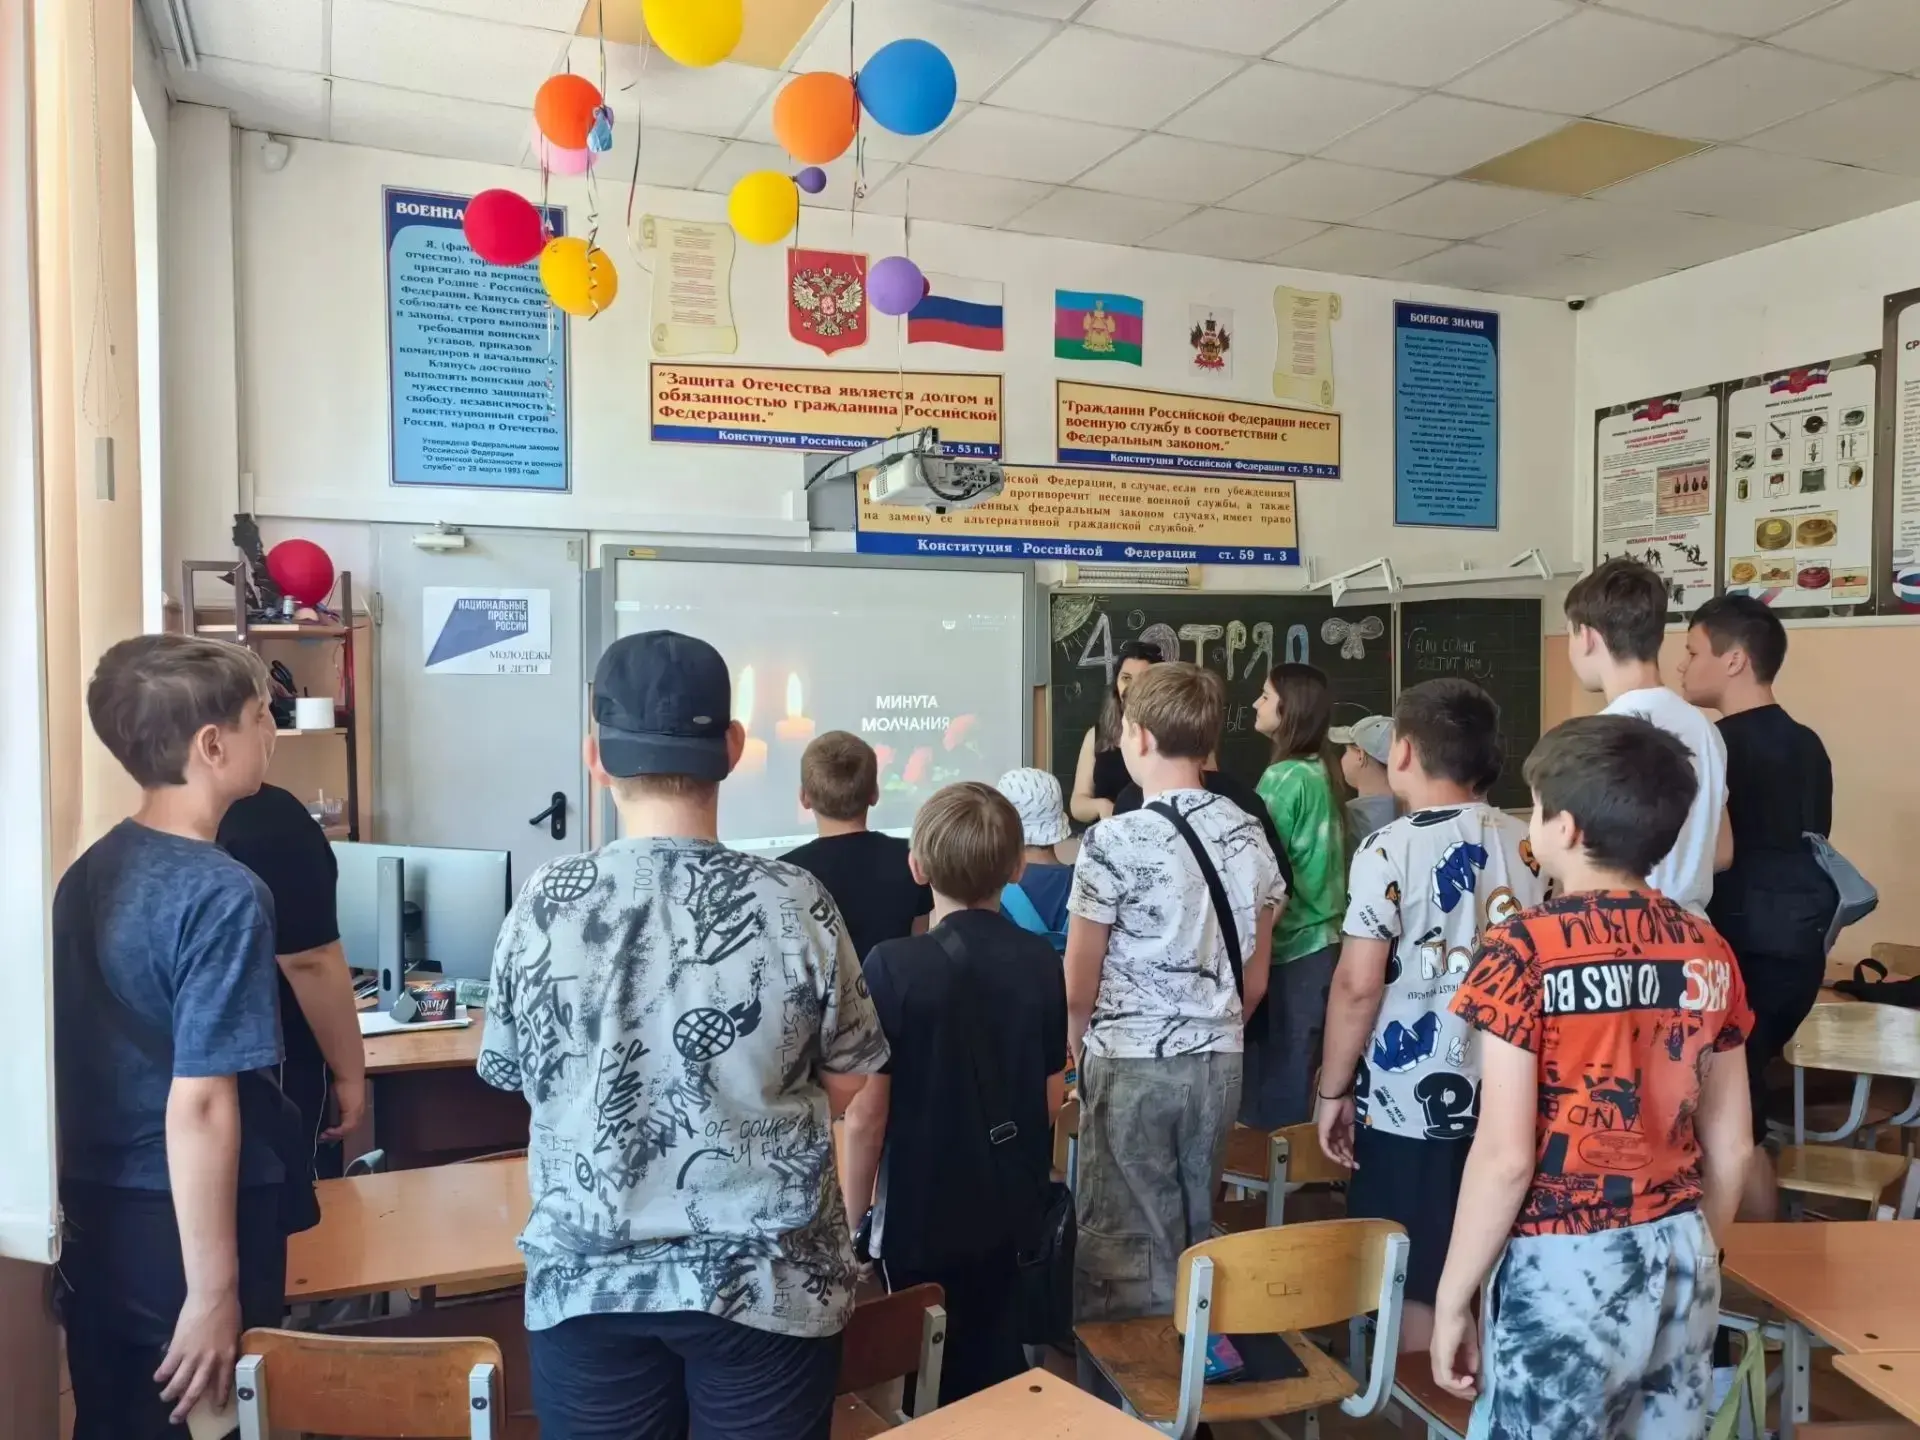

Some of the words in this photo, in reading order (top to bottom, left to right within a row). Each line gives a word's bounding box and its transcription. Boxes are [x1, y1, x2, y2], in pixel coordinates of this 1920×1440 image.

[396, 202, 464, 222] ВОЕННА
[414, 264, 470, 276] присягаю
[401, 274, 434, 284] своей
[438, 276, 479, 288] Родине
[490, 282, 548, 298] Российско
[401, 286, 470, 300] Федерации.
[474, 292, 519, 304] Клянусь
[399, 298, 461, 310] соблюдать
[458, 316, 495, 326] строго
[1410, 312, 1449, 324] БОЕВОЕ
[1452, 318, 1484, 330] ЗНАМЯ
[418, 324, 484, 336] требования
[488, 330, 540, 340] воинских
[400, 346, 470, 358] командиров
[480, 342, 532, 352] приказов
[429, 360, 476, 370] Клянусь
[479, 364, 531, 374] достойно
[404, 372, 467, 382] выполнять
[471, 376, 523, 386] воинский
[412, 384, 488, 394] мужественно
[742, 378, 831, 396] Отечества
[839, 388, 914, 400] является
[921, 392, 977, 404] долгом
[984, 396, 993, 406] и
[461, 398, 543, 410] независимость
[659, 388, 787, 408] обязанностью
[794, 400, 897, 416] гражданина
[904, 404, 997, 422] Российской
[412, 408, 514, 420] конституционный
[518, 414, 548, 424] строй
[1149, 406, 1224, 422] Российской
[1228, 412, 1296, 428] Федерации
[1300, 420, 1331, 430] несет
[452, 422, 484, 430] народ
[1066, 418, 1126, 432] военную
[1130, 420, 1179, 436] службу
[1184, 426, 1191, 434] в
[1195, 426, 1278, 440] соответствии
[1281, 432, 1288, 442] с
[719, 430, 796, 444] Конституция
[801, 436, 868, 450] Российской
[958, 444, 972, 454] 53
[1066, 430, 1162, 448] Федеральным
[1111, 454, 1174, 466] Конституция
[1177, 454, 1231, 468] Российской
[1288, 462, 1300, 472] ст.
[1303, 462, 1314, 474] 53
[1317, 464, 1325, 474] п.
[1048, 476, 1116, 490] Федерации,
[1131, 482, 1170, 492] случае,
[1204, 486, 1220, 494] его
[1227, 486, 1290, 498] убеждениям
[1010, 490, 1090, 502] противоречит
[1099, 494, 1142, 504] несение
[1148, 496, 1190, 506] военной
[1198, 498, 1239, 510] службы,
[1260, 502, 1290, 510] также
[889, 514, 932, 526] замену
[941, 514, 953, 524] ее
[964, 516, 1059, 528] альтернативной
[1068, 520, 1140, 530] гражданской
[1029, 502, 1110, 516] федеральным
[1120, 510, 1164, 518] законом
[1173, 512, 1219, 522] случаях,
[1261, 516, 1290, 526] право
[918, 538, 1012, 554] Конституция
[1022, 542, 1102, 556] Российской
[1124, 546, 1196, 560] Федерации
[1218, 552, 1234, 560] ст.
[1240, 550, 1254, 560] 59
[1280, 550, 1287, 562] 3
[458, 600, 527, 610] НАЦИОНАЛЬНЫЕ
[488, 610, 526, 620] ПРОЕКТЫ
[496, 621, 526, 631] РОССИИ
[498, 664, 505, 672] И
[510, 664, 538, 673] ДЕТИ
[876, 695, 938, 709] МИНУТА
[861, 717, 950, 732] МОЛЧАНИЯ
